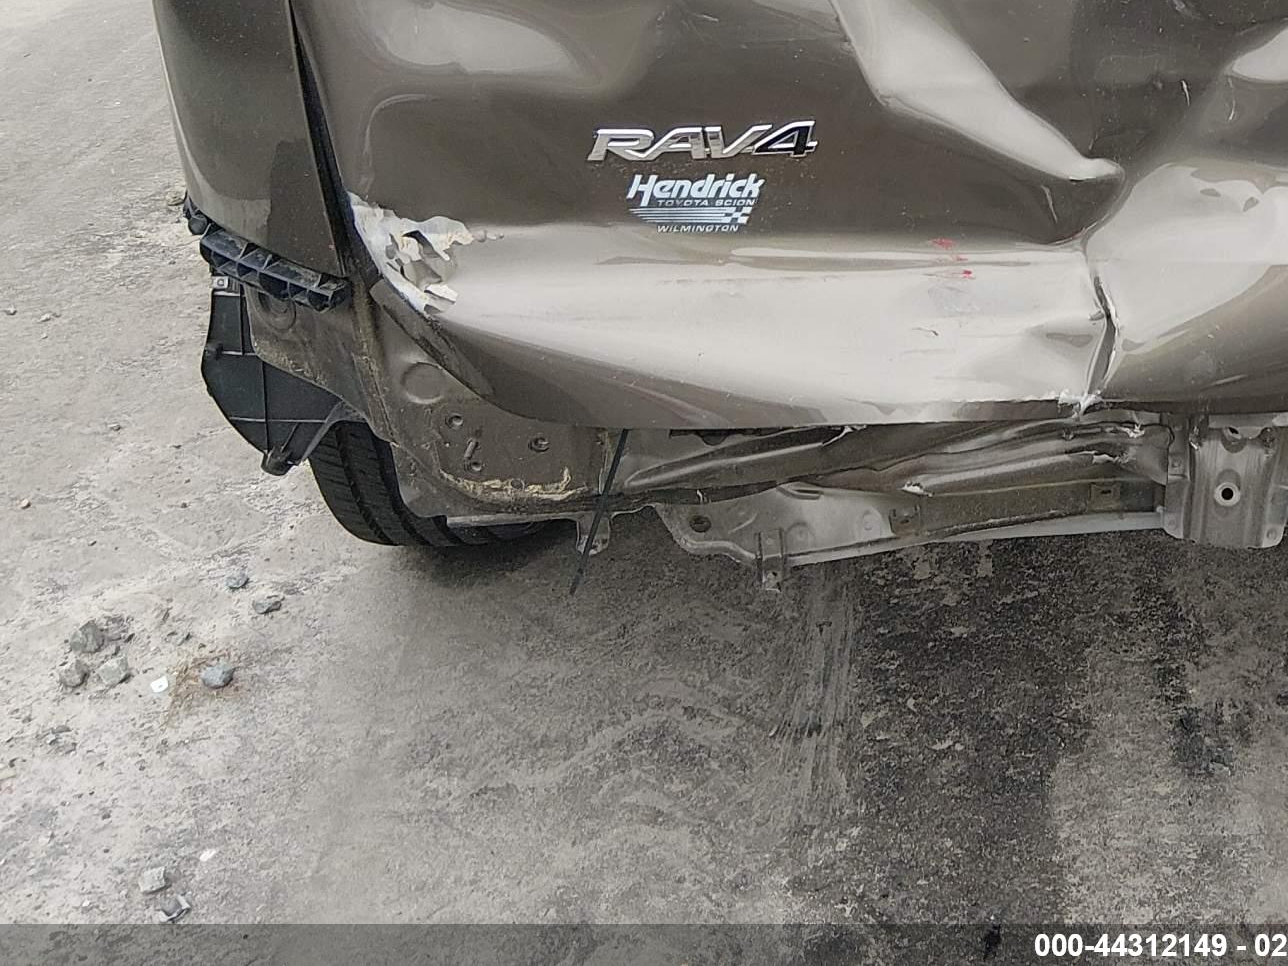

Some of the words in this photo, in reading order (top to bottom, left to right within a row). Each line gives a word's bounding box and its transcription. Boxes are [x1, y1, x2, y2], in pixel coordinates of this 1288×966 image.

[587, 120, 819, 162] RAV4
[626, 172, 765, 208] Hendrick
[657, 198, 708, 208] TOYOTA
[714, 198, 756, 207] SCION
[656, 224, 739, 233] WILMINGTON
